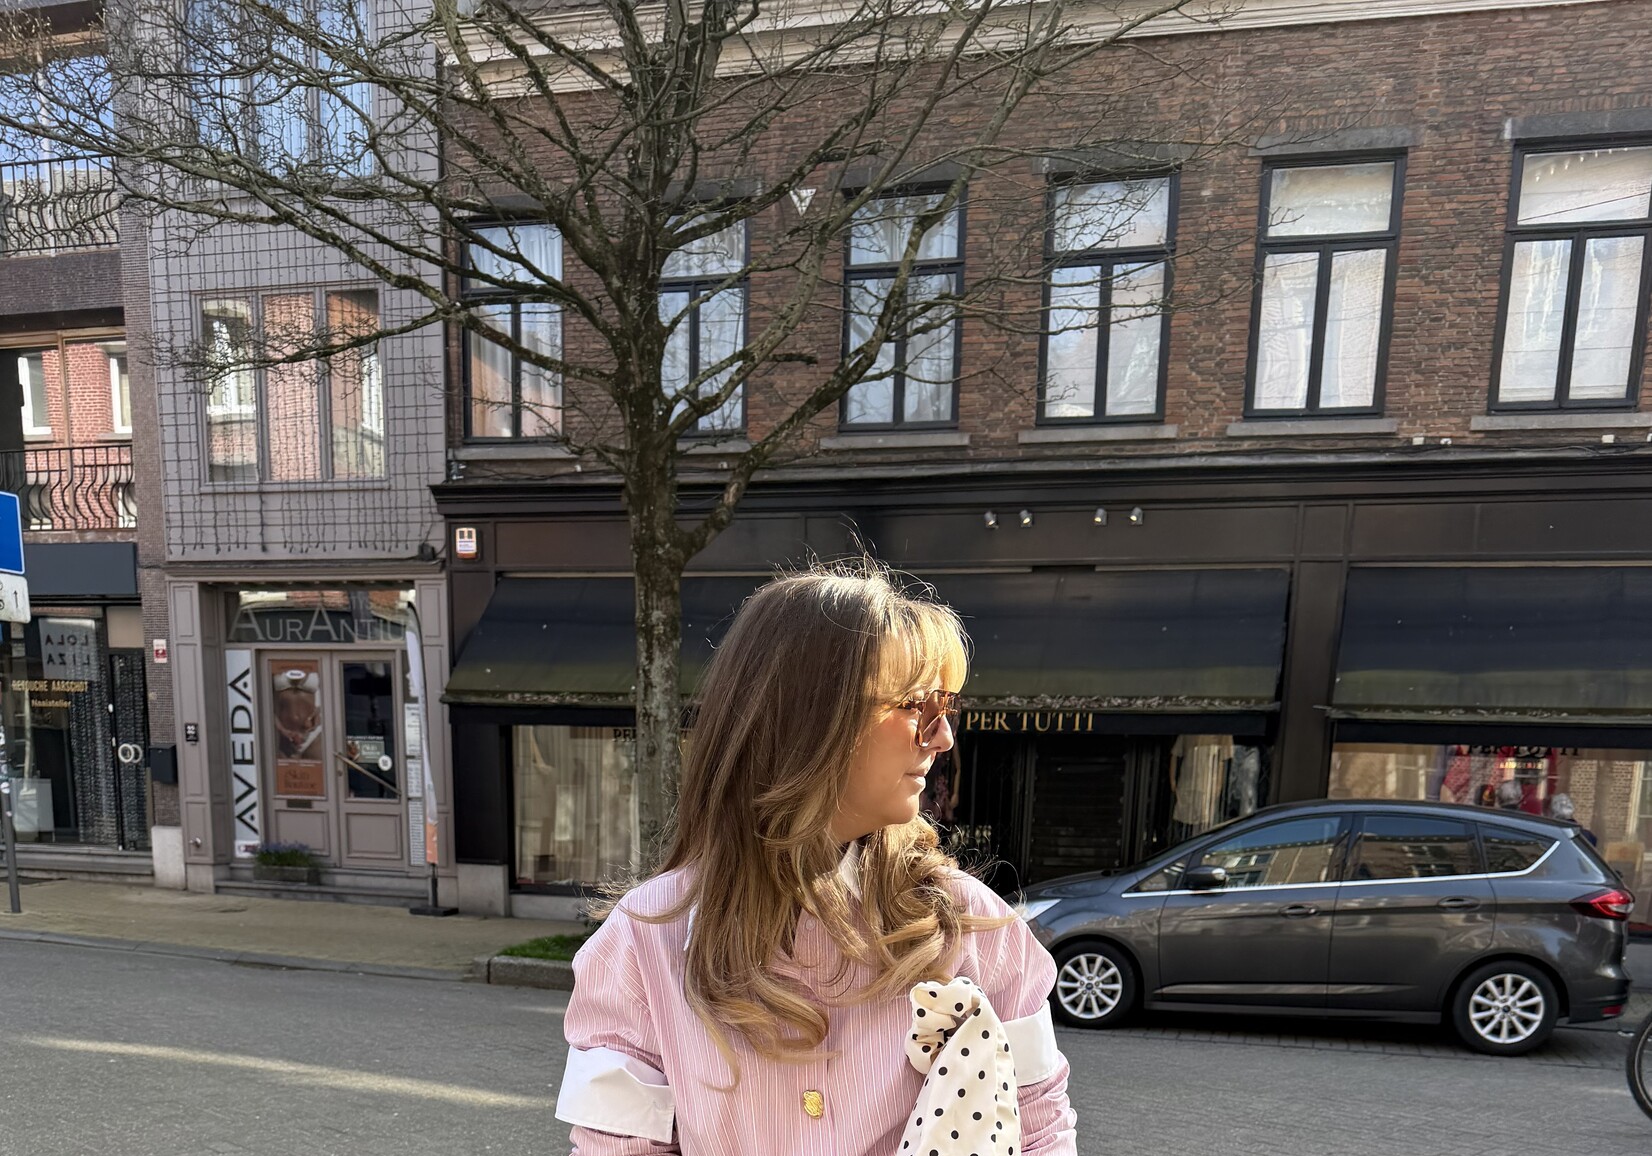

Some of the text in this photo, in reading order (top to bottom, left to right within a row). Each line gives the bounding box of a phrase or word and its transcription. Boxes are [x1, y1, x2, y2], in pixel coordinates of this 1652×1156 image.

[228, 668, 259, 835] AVEDA
[965, 711, 1094, 732] PER TUTTI
